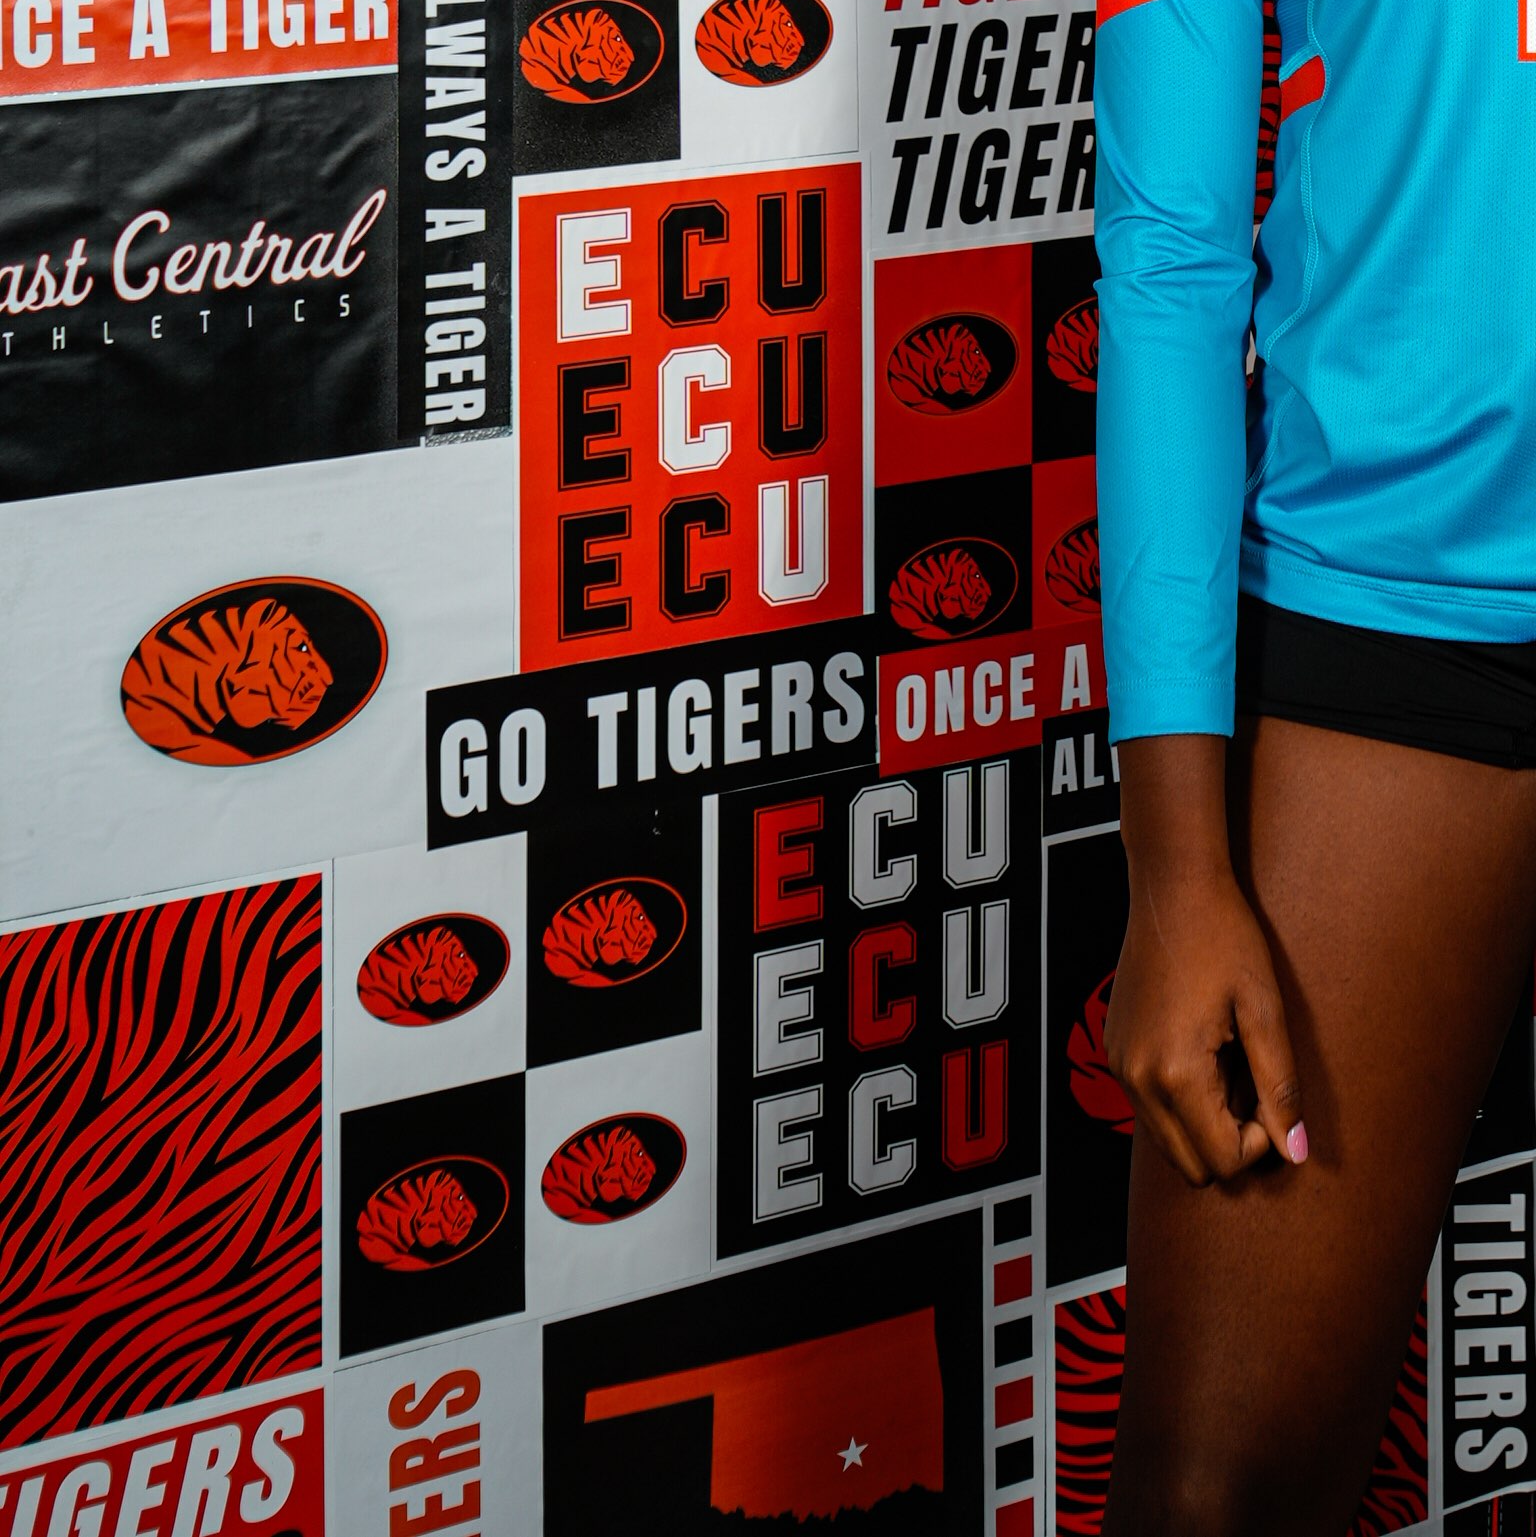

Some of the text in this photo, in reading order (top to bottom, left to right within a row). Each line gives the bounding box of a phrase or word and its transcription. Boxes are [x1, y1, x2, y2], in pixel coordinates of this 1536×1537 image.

[885, 10, 1097, 123] TIGER
[0, 189, 388, 315] ast Central
[424, 208, 487, 243] A
[887, 117, 1095, 234] TIGER
[1, 294, 351, 357] THLETICS
[424, 261, 487, 426] TIGER
[556, 188, 828, 343] ECU
[557, 331, 829, 491] ECU
[557, 474, 829, 644] ECU
[438, 650, 865, 820] GO TIGERS
[895, 643, 1092, 742] ONCE A
[753, 760, 1010, 934] ECU
[753, 898, 1010, 1078] ECU
[752, 1039, 1010, 1224] ECU
[1453, 1193, 1528, 1473] TIGERS
[0, 1406, 304, 1537] IGERS
